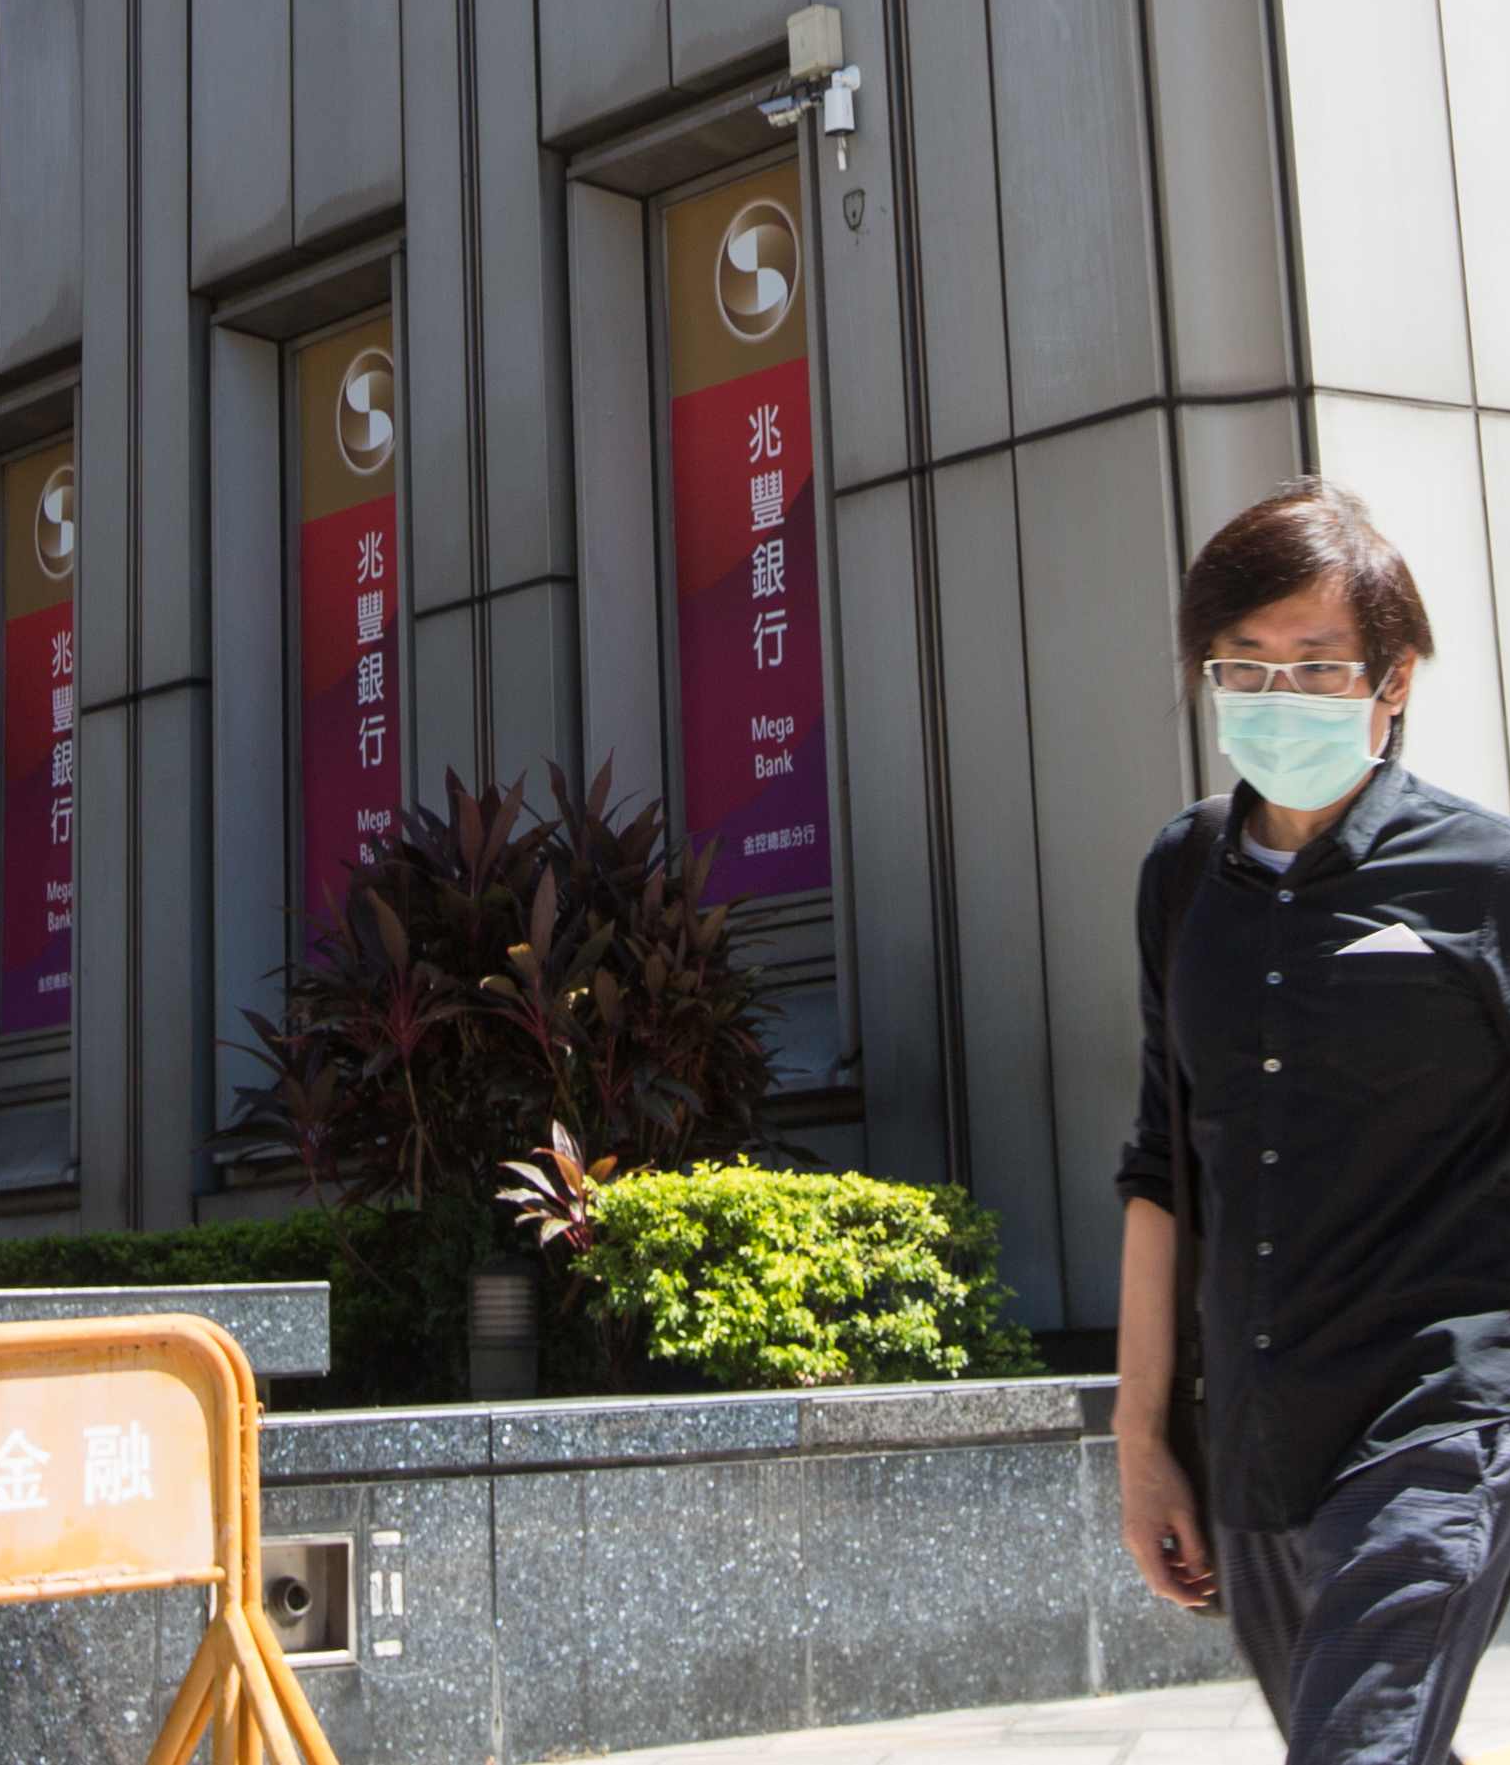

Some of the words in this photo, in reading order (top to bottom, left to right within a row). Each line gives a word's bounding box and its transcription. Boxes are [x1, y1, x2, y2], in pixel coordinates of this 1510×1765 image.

[748, 403, 788, 670] 兆豐銀行
[356, 530, 386, 769] 兆豐銀行
[50, 629, 73, 845] 兆豐銀行
[751, 714, 794, 743] Mega
[755, 748, 794, 779] Bank
[357, 808, 391, 834] Mega
[360, 839, 389, 864] Ba
